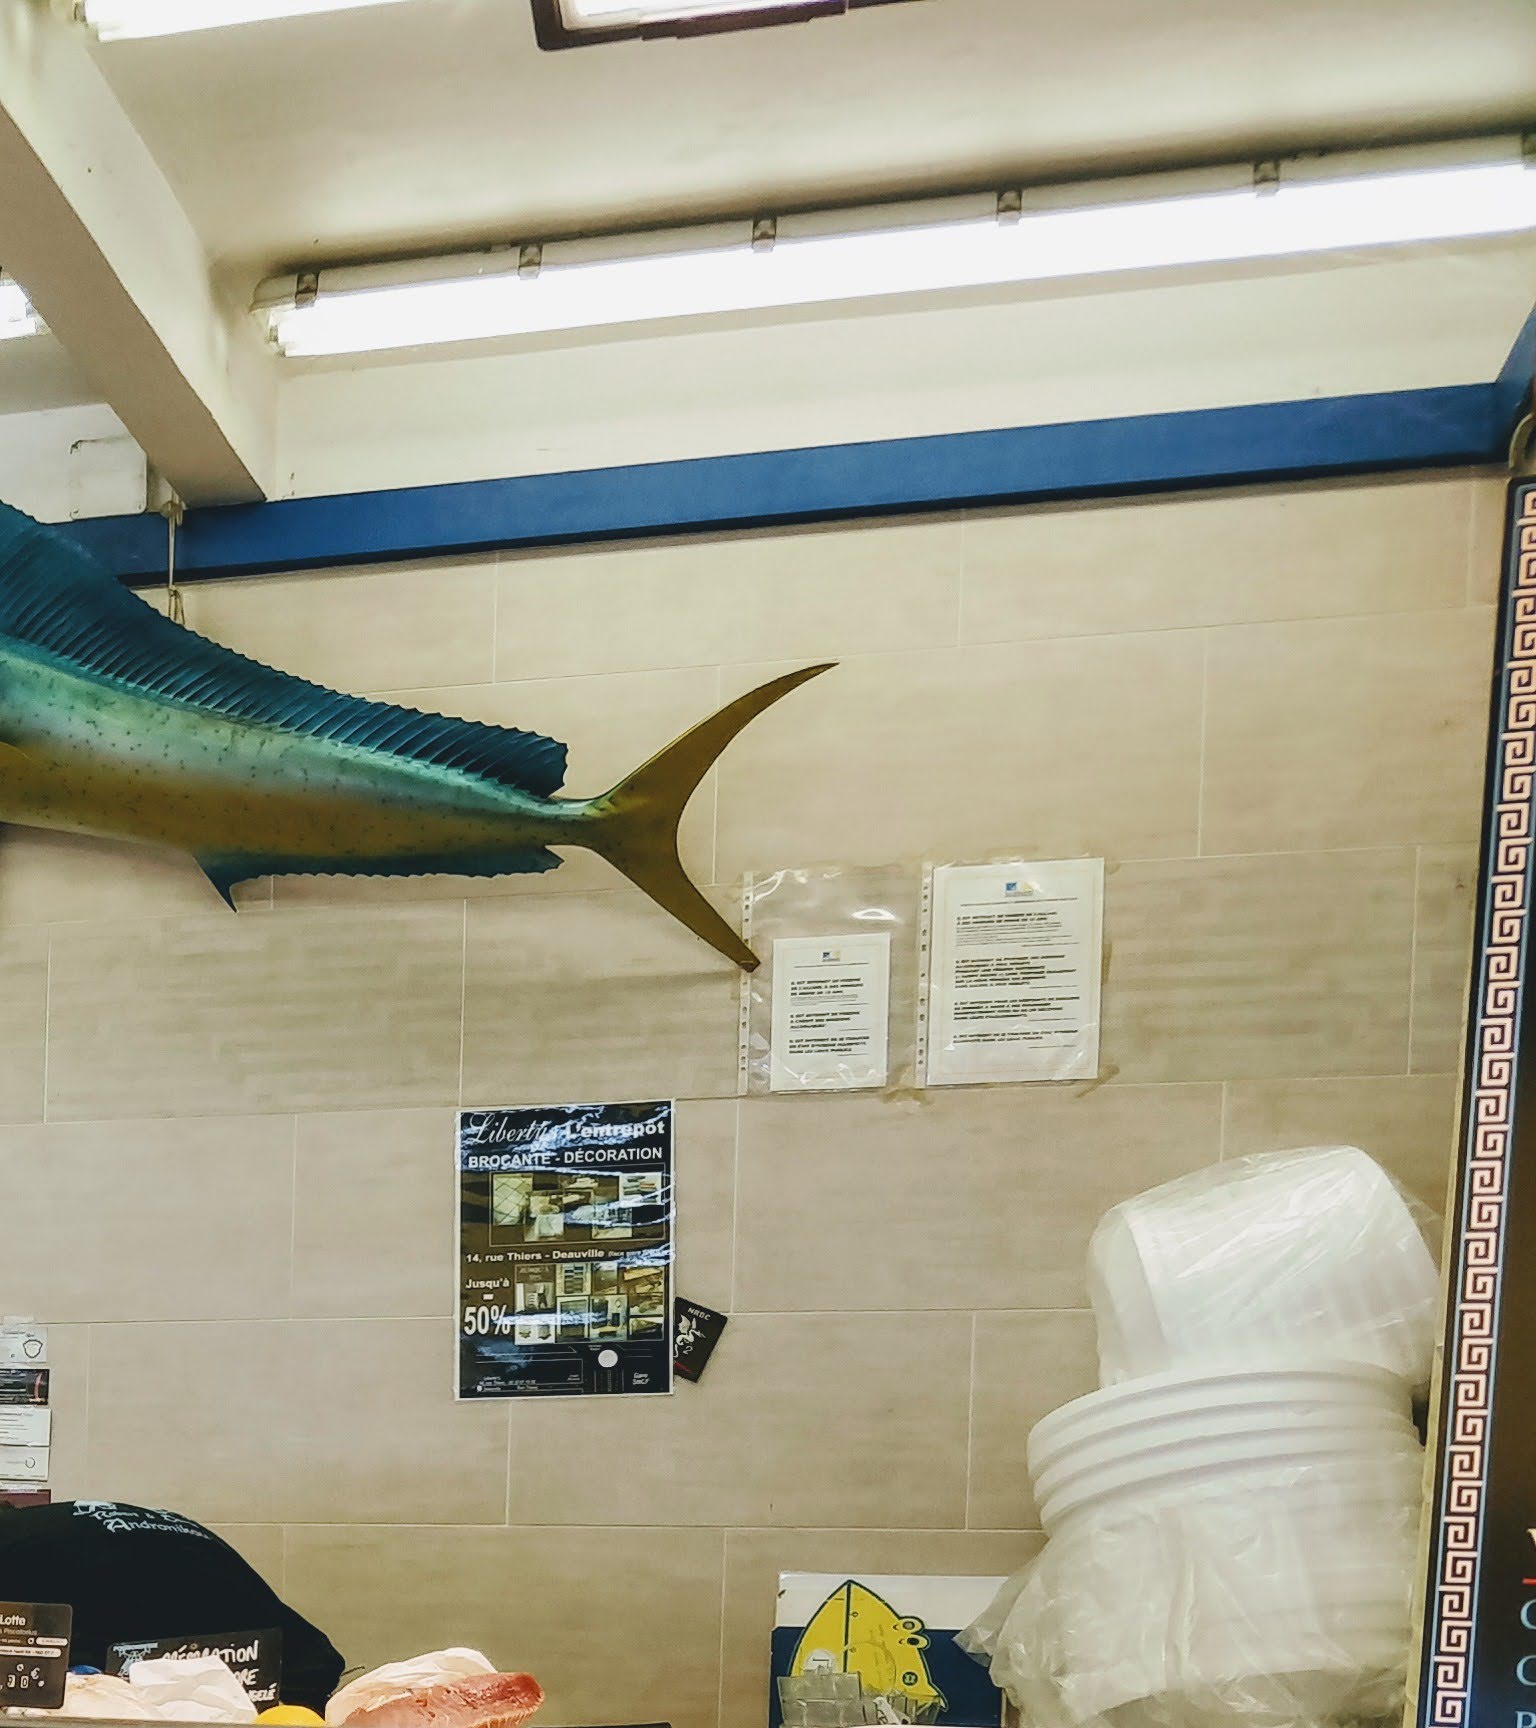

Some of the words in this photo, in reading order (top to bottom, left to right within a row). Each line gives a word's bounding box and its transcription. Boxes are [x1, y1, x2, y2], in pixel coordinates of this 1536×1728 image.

[468, 1153, 551, 1168] BROCANTE
[564, 1147, 663, 1164] DÉCORATION
[485, 1253, 504, 1262] rue
[507, 1251, 542, 1261] Thiers
[552, 1249, 604, 1259] Deauville
[465, 1278, 510, 1289] Jusqu'à
[463, 1304, 512, 1336] 50%
